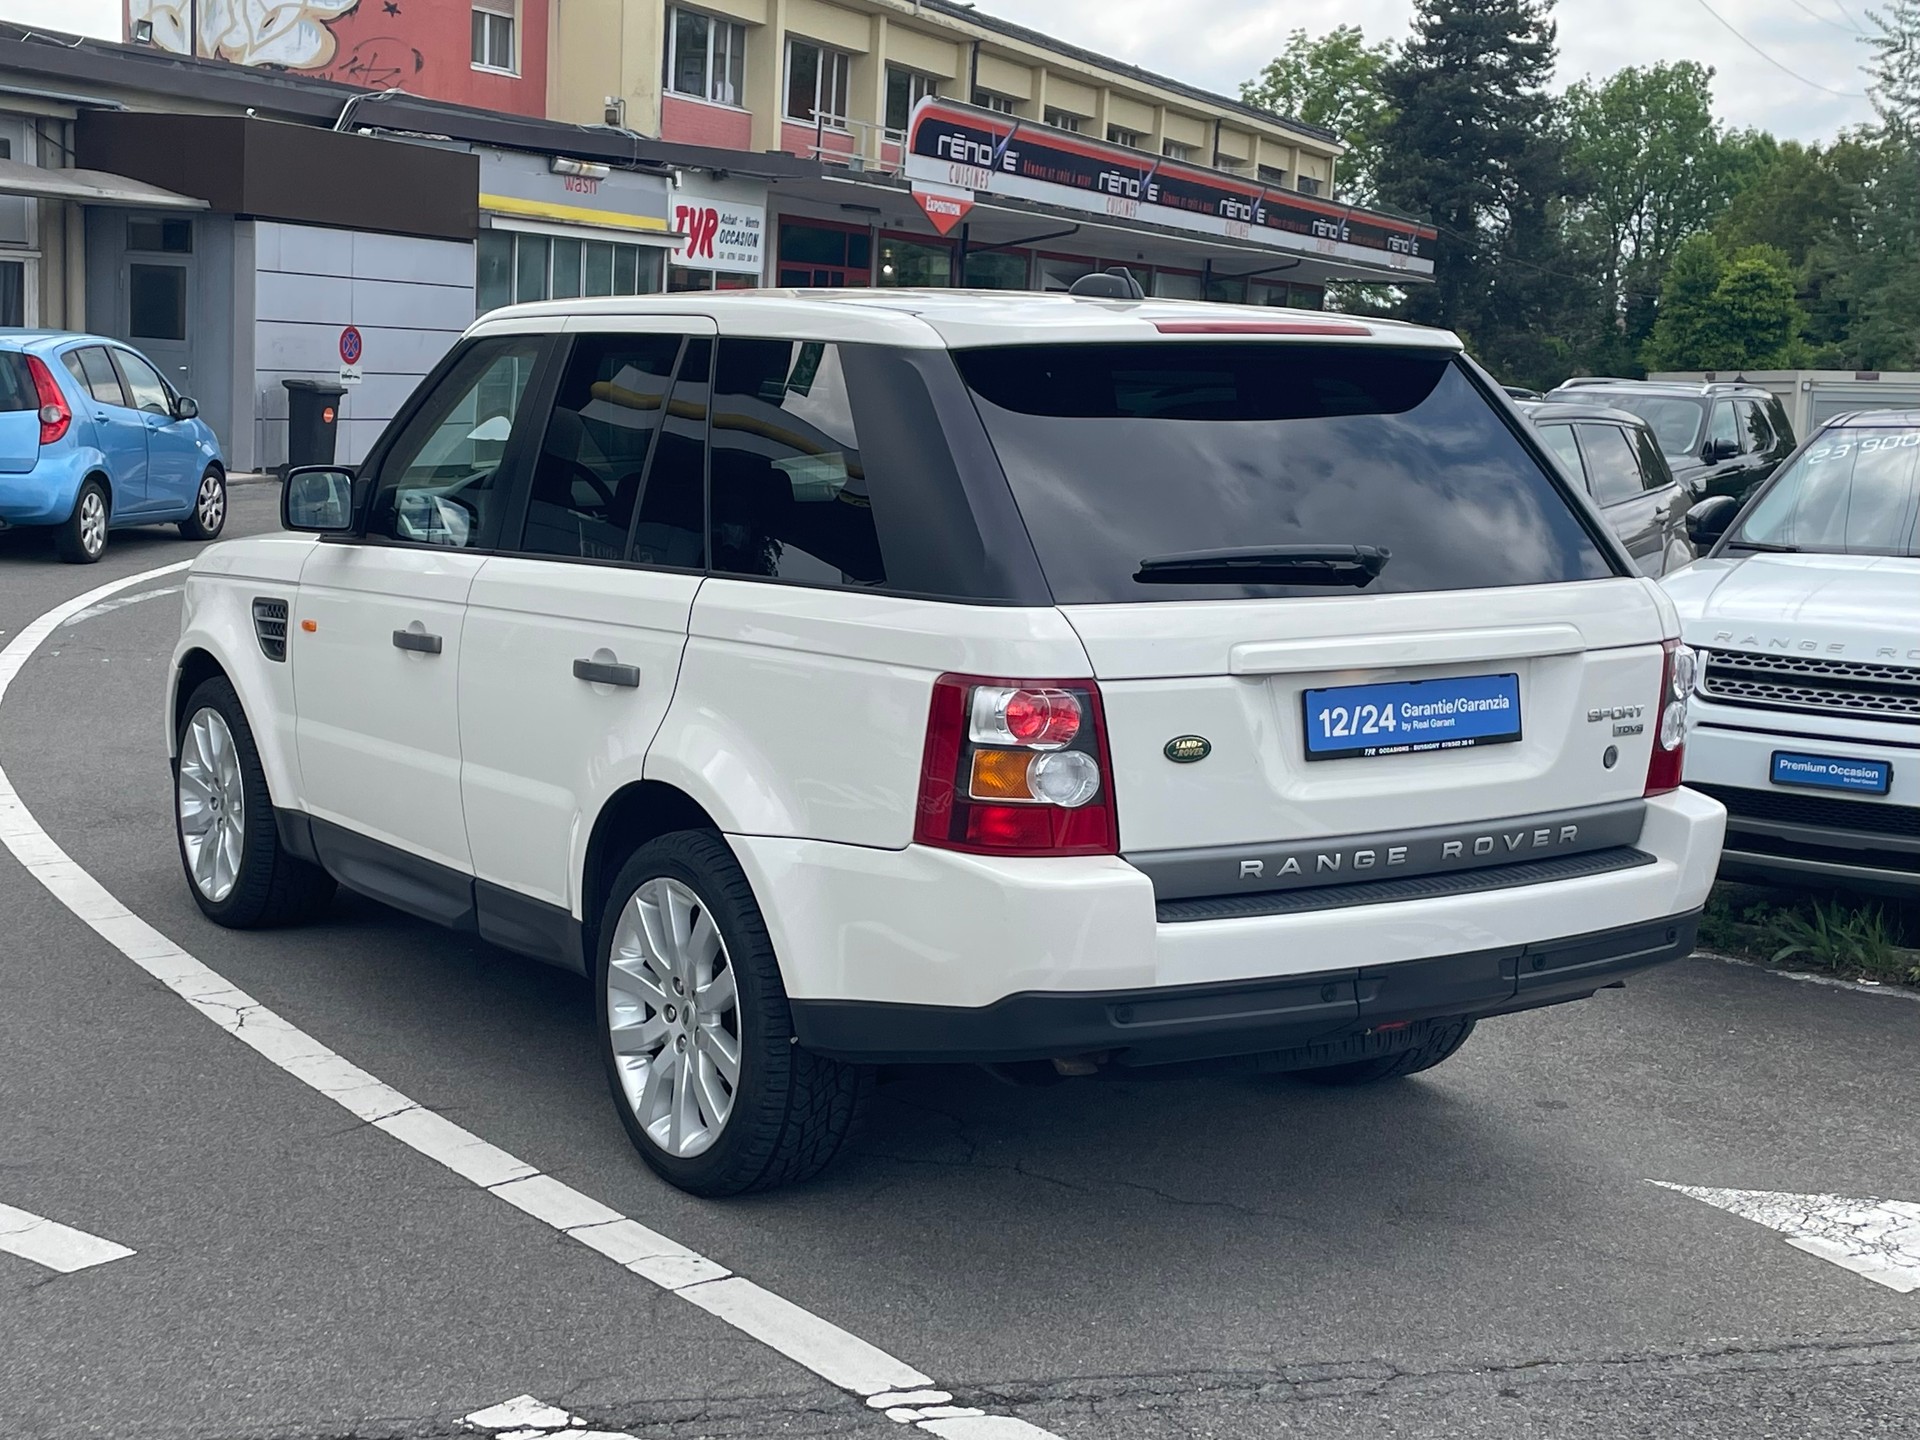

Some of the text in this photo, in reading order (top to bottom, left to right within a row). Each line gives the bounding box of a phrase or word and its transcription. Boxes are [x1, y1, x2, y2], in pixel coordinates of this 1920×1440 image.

[949, 163, 989, 190] CUISINES
[1106, 197, 1137, 218] CUISINES
[720, 214, 738, 226] Achat
[674, 206, 719, 259] TYR
[719, 229, 760, 248] OCCASION
[1713, 630, 1846, 654] RANGE
[1401, 694, 1510, 718] Garantie/Garanzia
[1587, 704, 1645, 723] SPORT
[1319, 703, 1397, 738] 12/24
[1402, 717, 1456, 732] by Real Garant
[1176, 740, 1198, 749] LAND
[1176, 748, 1204, 757] ROVER
[1779, 759, 1879, 779] Premium Occasion
[1239, 825, 1578, 880] RANGE ROVER
